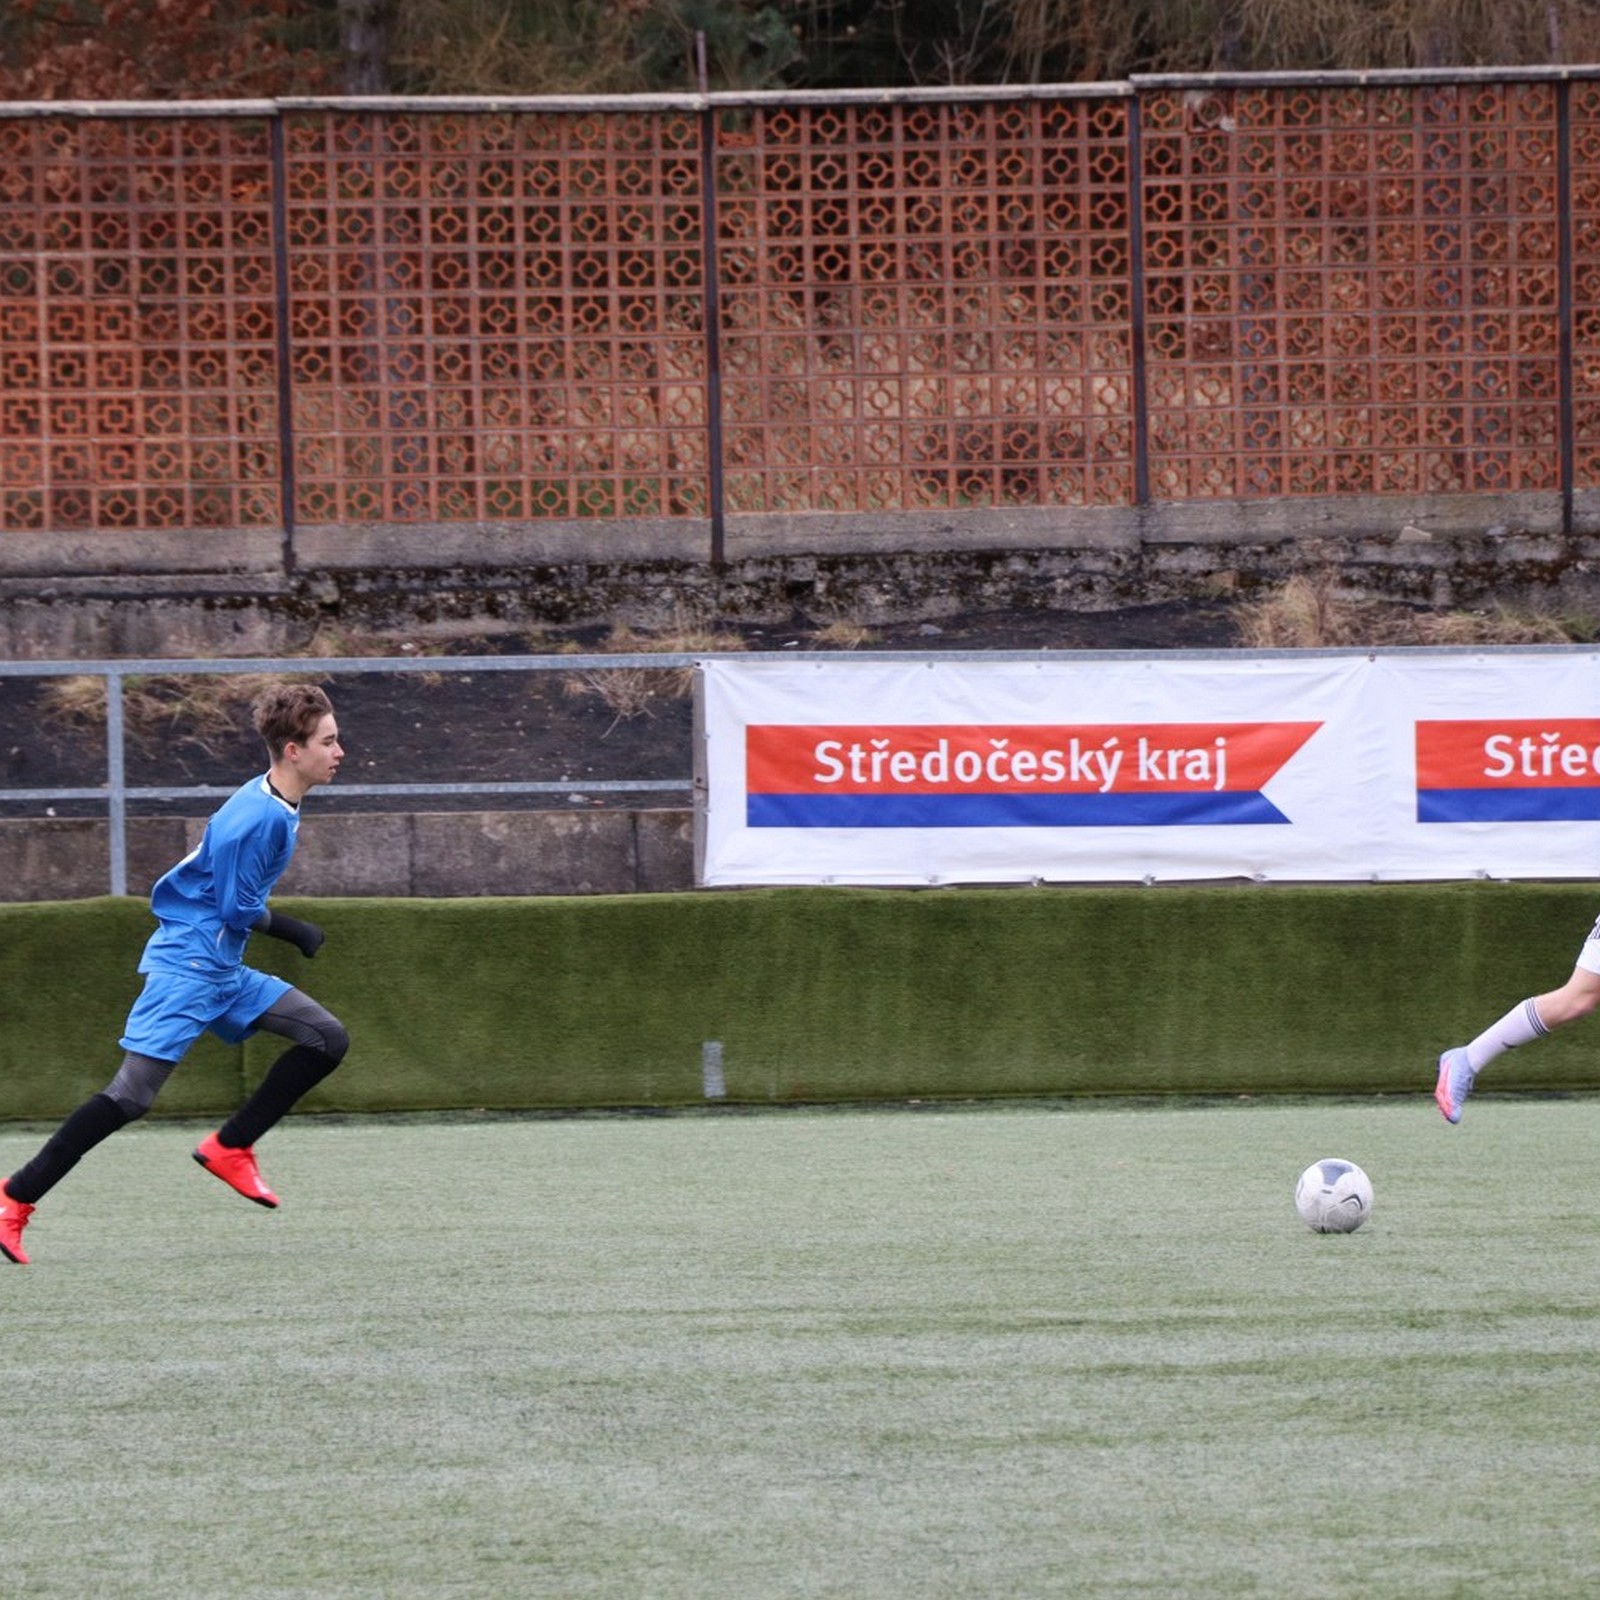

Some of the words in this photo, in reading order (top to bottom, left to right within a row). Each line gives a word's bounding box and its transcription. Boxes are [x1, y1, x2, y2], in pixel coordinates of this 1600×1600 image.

[813, 737, 1123, 793] Středočeský
[1138, 736, 1227, 792] kraj
[1483, 732, 1600, 778] Stře
